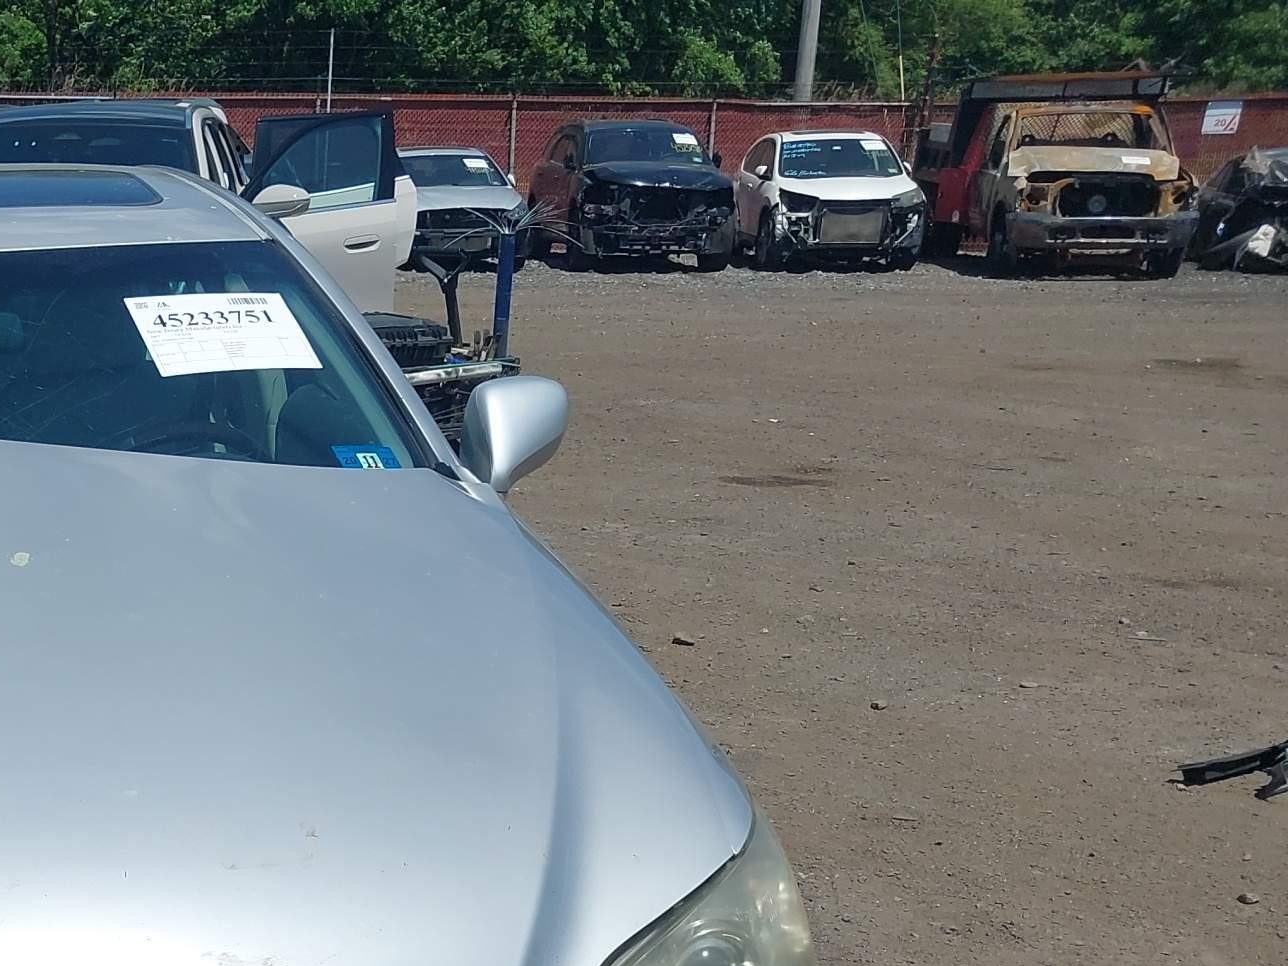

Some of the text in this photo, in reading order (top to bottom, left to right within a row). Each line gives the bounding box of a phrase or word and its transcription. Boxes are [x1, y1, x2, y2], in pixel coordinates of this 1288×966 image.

[1214, 119, 1227, 127] 20
[153, 310, 274, 328] 45233751
[342, 456, 357, 465] 20
[362, 455, 381, 469] 11
